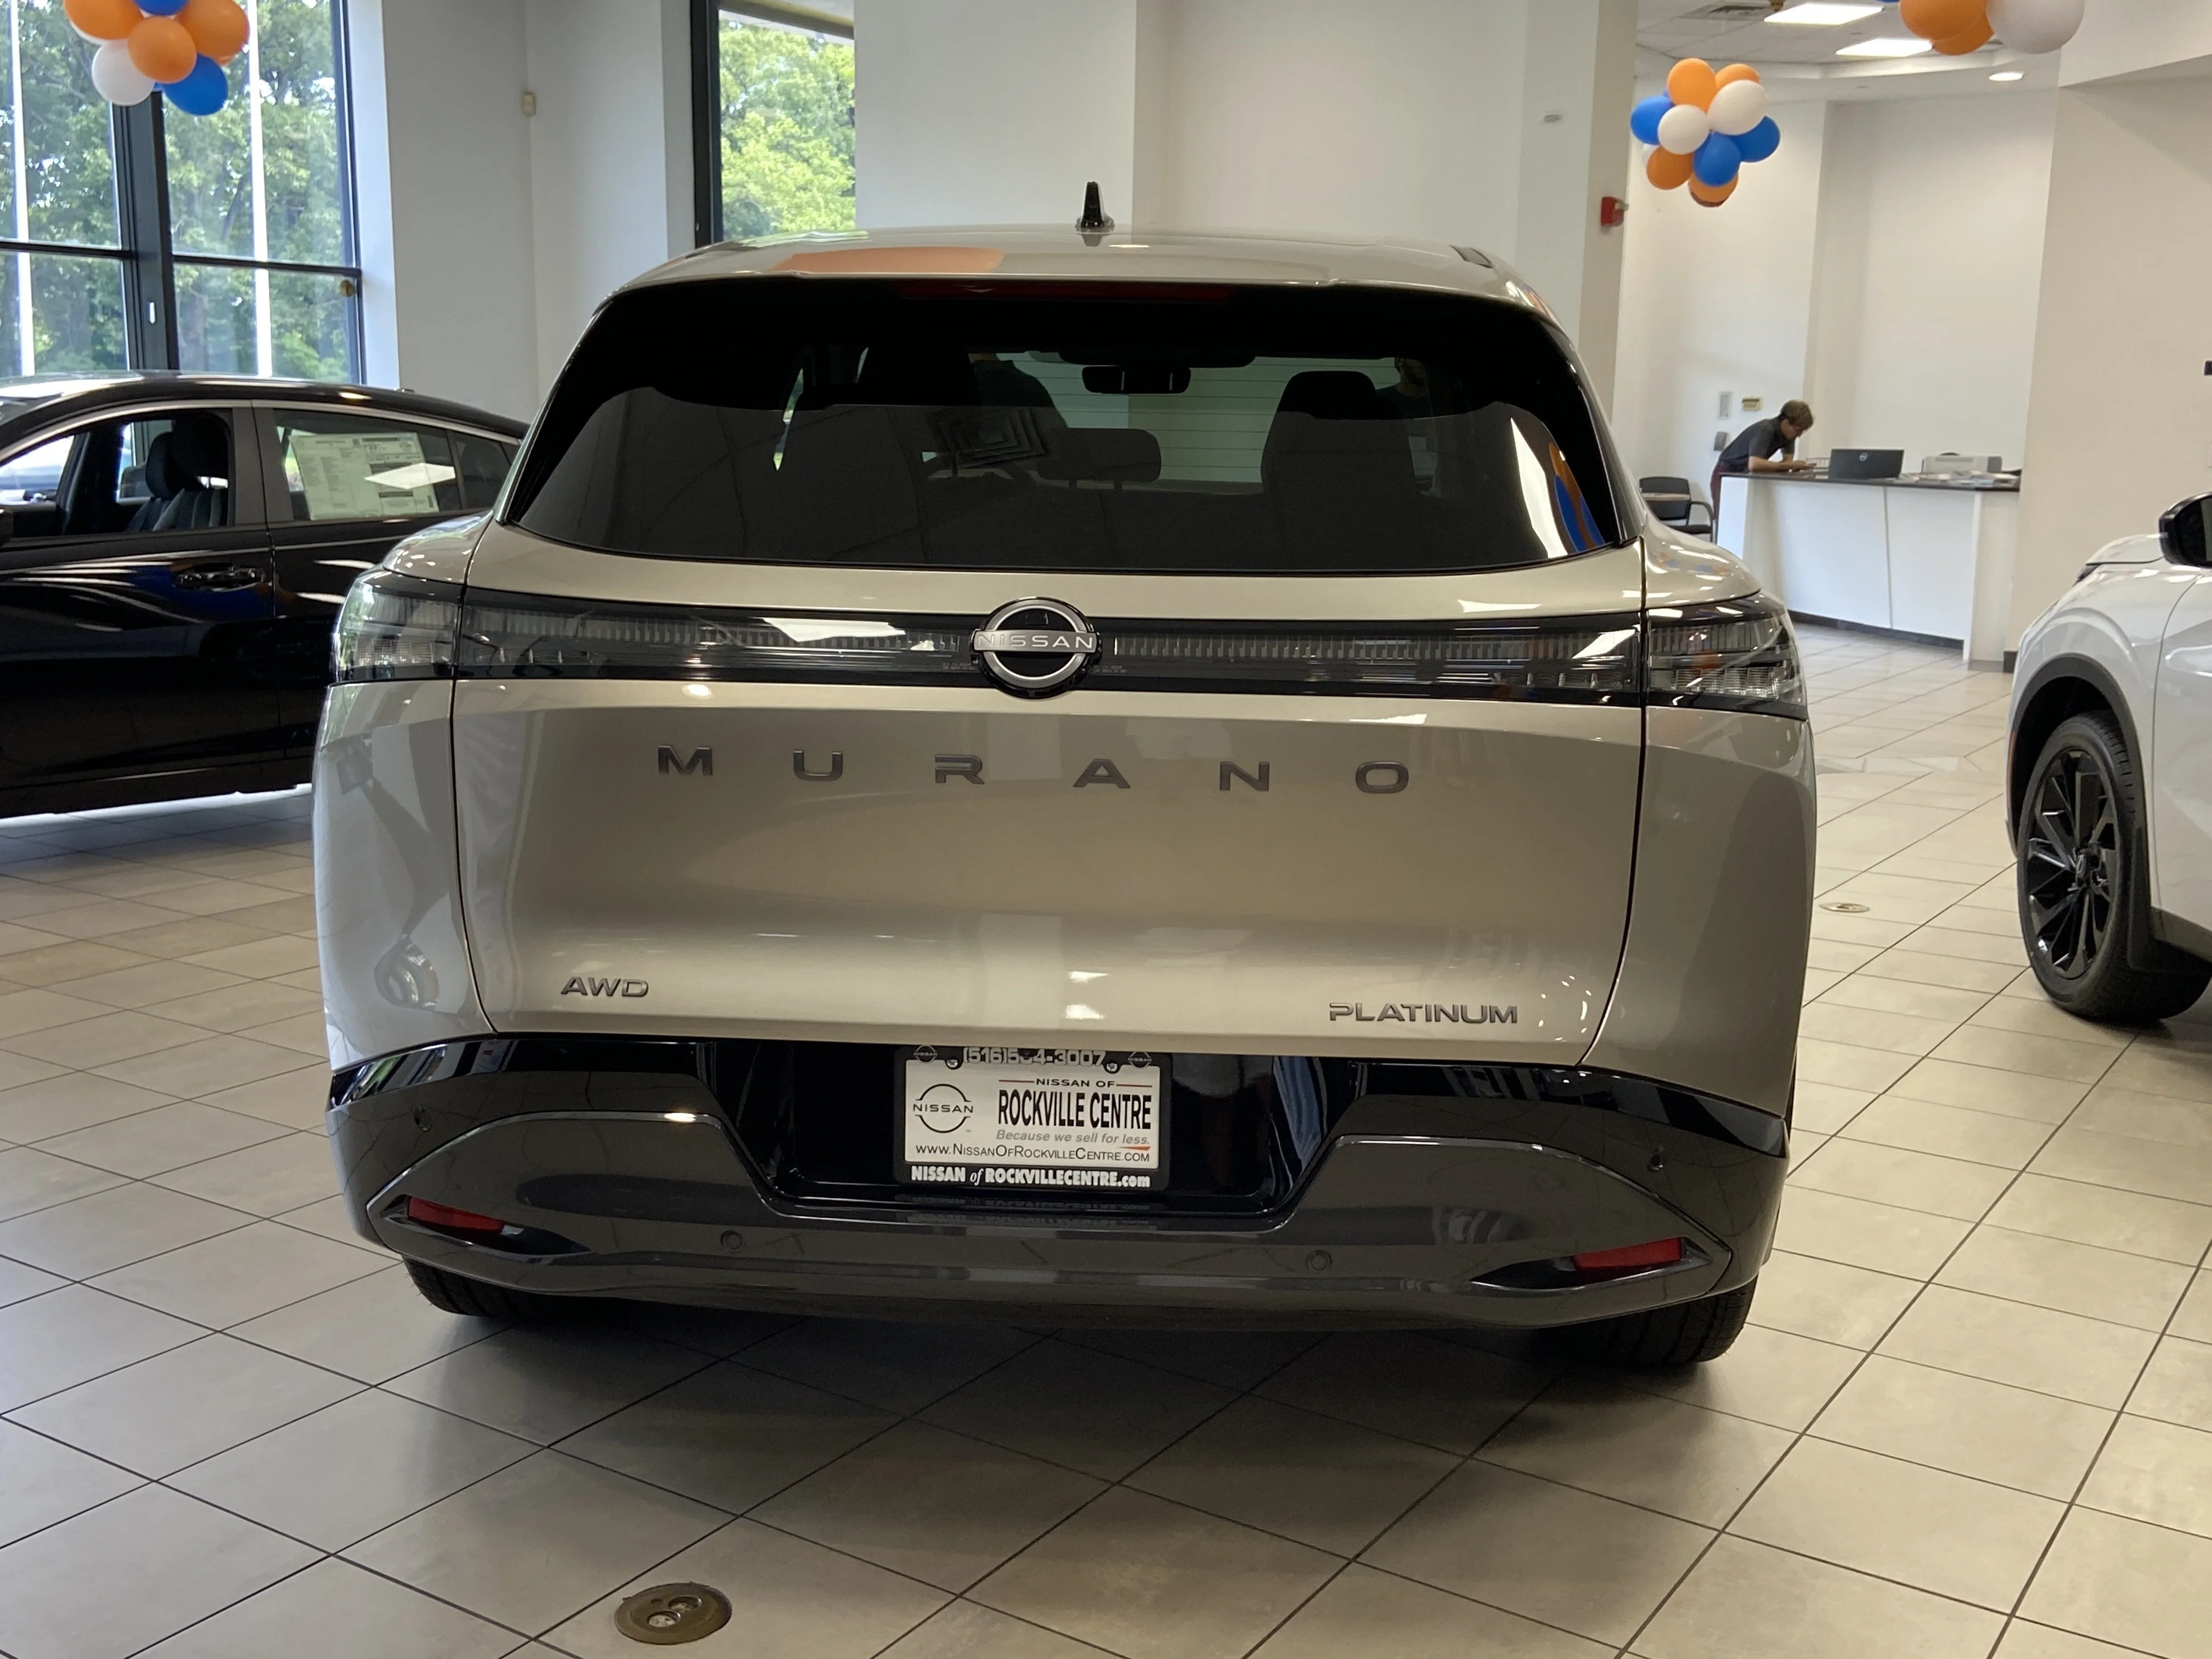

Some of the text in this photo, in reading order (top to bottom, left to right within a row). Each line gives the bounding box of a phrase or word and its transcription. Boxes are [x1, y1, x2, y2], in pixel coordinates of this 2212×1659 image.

[978, 634, 1093, 648] NISSAN
[658, 744, 1409, 794] MURANO
[561, 977, 649, 997] AWD
[1329, 1002, 1517, 1024] PLATINUM
[1036, 1079, 1090, 1087] NISSAN
[913, 1104, 974, 1113] NISSAN
[998, 1089, 1152, 1130] ROCKVILLE CENTRE
[996, 1130, 1050, 1142] Because
[1075, 1132, 1098, 1143] sell
[1102, 1133, 1119, 1143] for
[1122, 1135, 1150, 1145] less.
[911, 1165, 1150, 1188] NISSAN of ROCKVILLECENTRE.com
